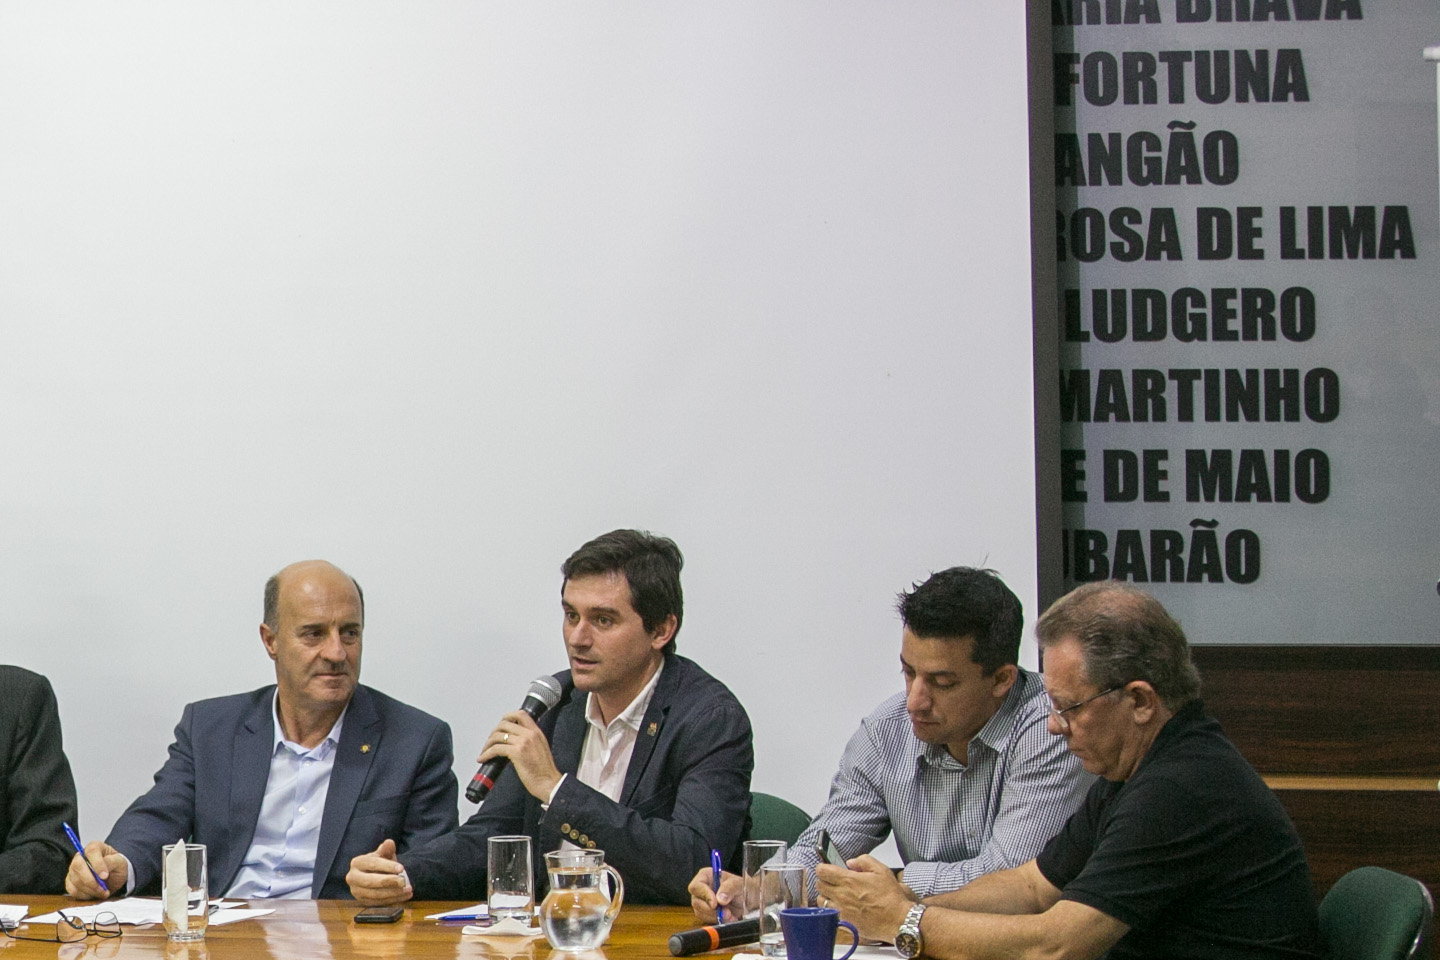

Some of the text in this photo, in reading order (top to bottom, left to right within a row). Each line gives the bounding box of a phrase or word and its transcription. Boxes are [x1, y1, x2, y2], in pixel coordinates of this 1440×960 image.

[1053, 48, 1310, 106] FORTUNA
[1054, 120, 1240, 187] ANGÃO
[1056, 205, 1417, 263] OSA DE LIMA
[1064, 286, 1317, 343] LUDGERO
[1059, 367, 1341, 423] MARTINHO
[1103, 449, 1170, 503] DE
[1185, 448, 1331, 504] MAIO
[1062, 518, 1261, 585] BARÃO
